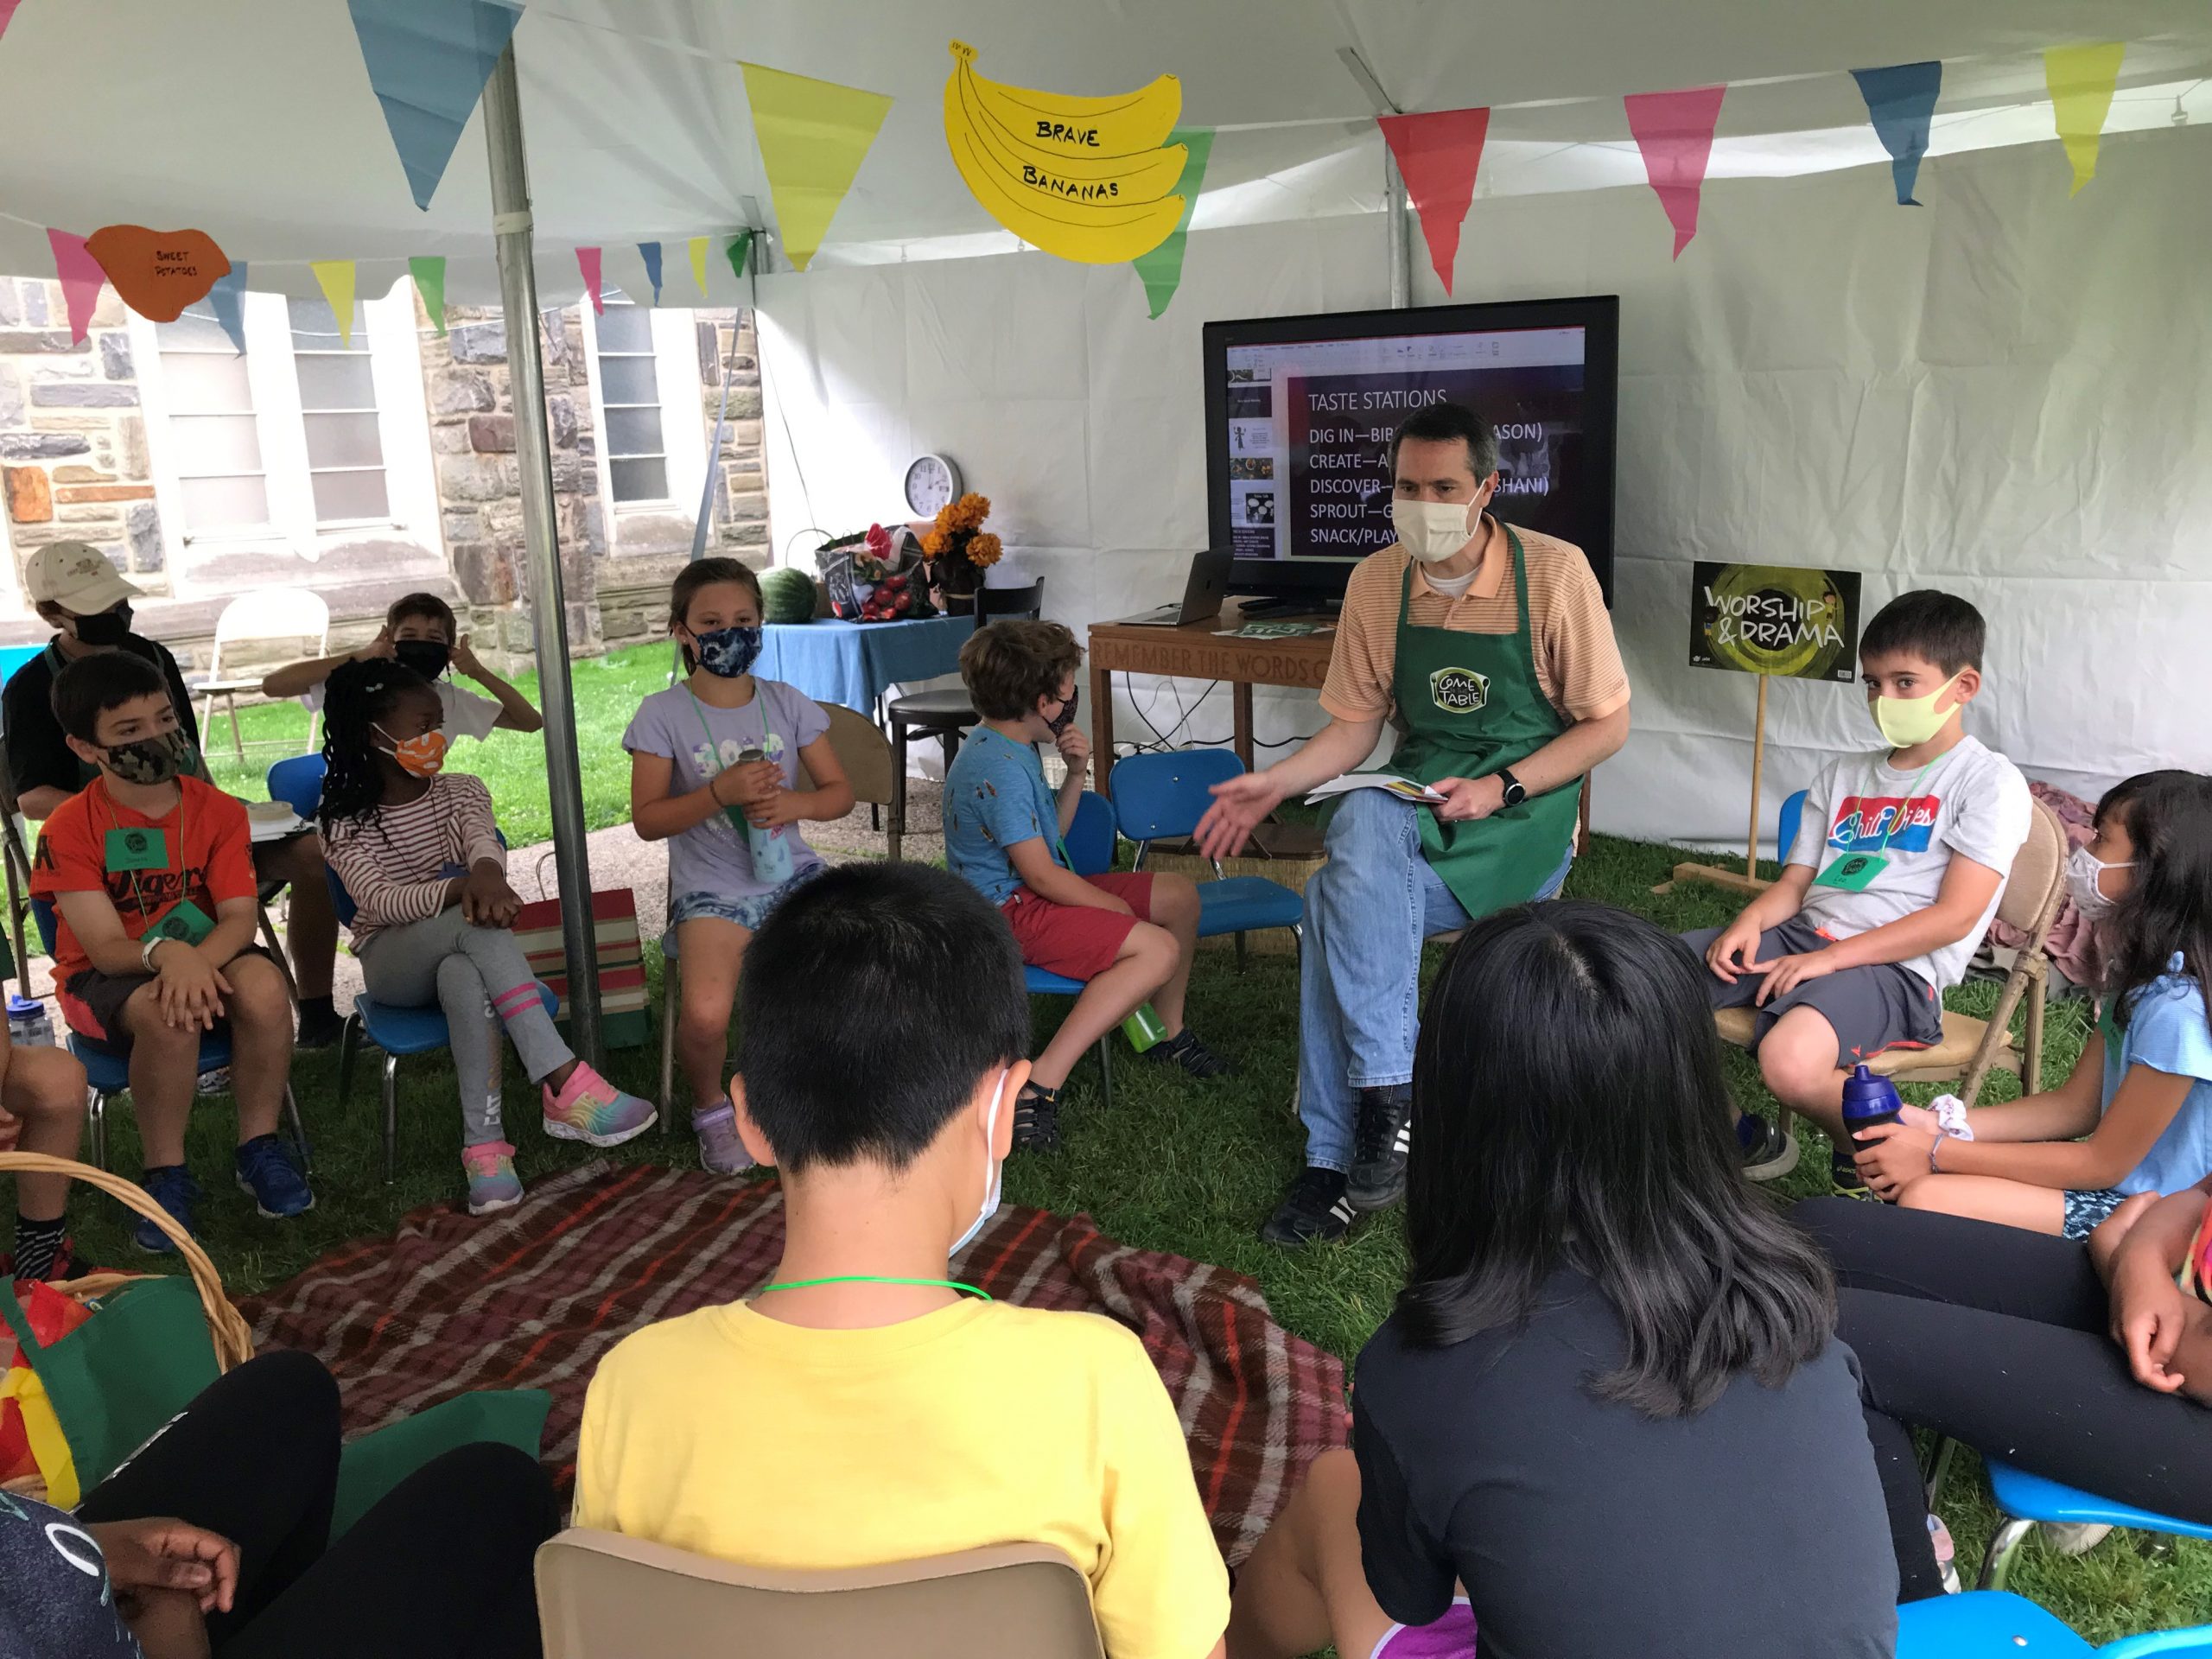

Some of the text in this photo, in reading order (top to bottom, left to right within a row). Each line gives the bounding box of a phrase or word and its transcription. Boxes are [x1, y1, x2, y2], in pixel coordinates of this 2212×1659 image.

[1036, 121, 1100, 147] BRAVE
[1022, 165, 1119, 200] BANANAS
[156, 251, 189, 262] SWEET
[155, 266, 198, 277] POTATOES
[1308, 389, 1447, 411] TASTE STATIONS
[1310, 429, 1335, 443] DIG
[1704, 586, 1826, 622] WORSHIP
[1740, 621, 1845, 648] DRAMA
[1092, 641, 1192, 672] REMEMBER
[1198, 650, 1230, 675] THE
[1236, 656, 1308, 681] WORDS
[1439, 675, 1475, 691] COME
[1439, 690, 1479, 706] TABLE
[1827, 810, 1883, 844] Chill
